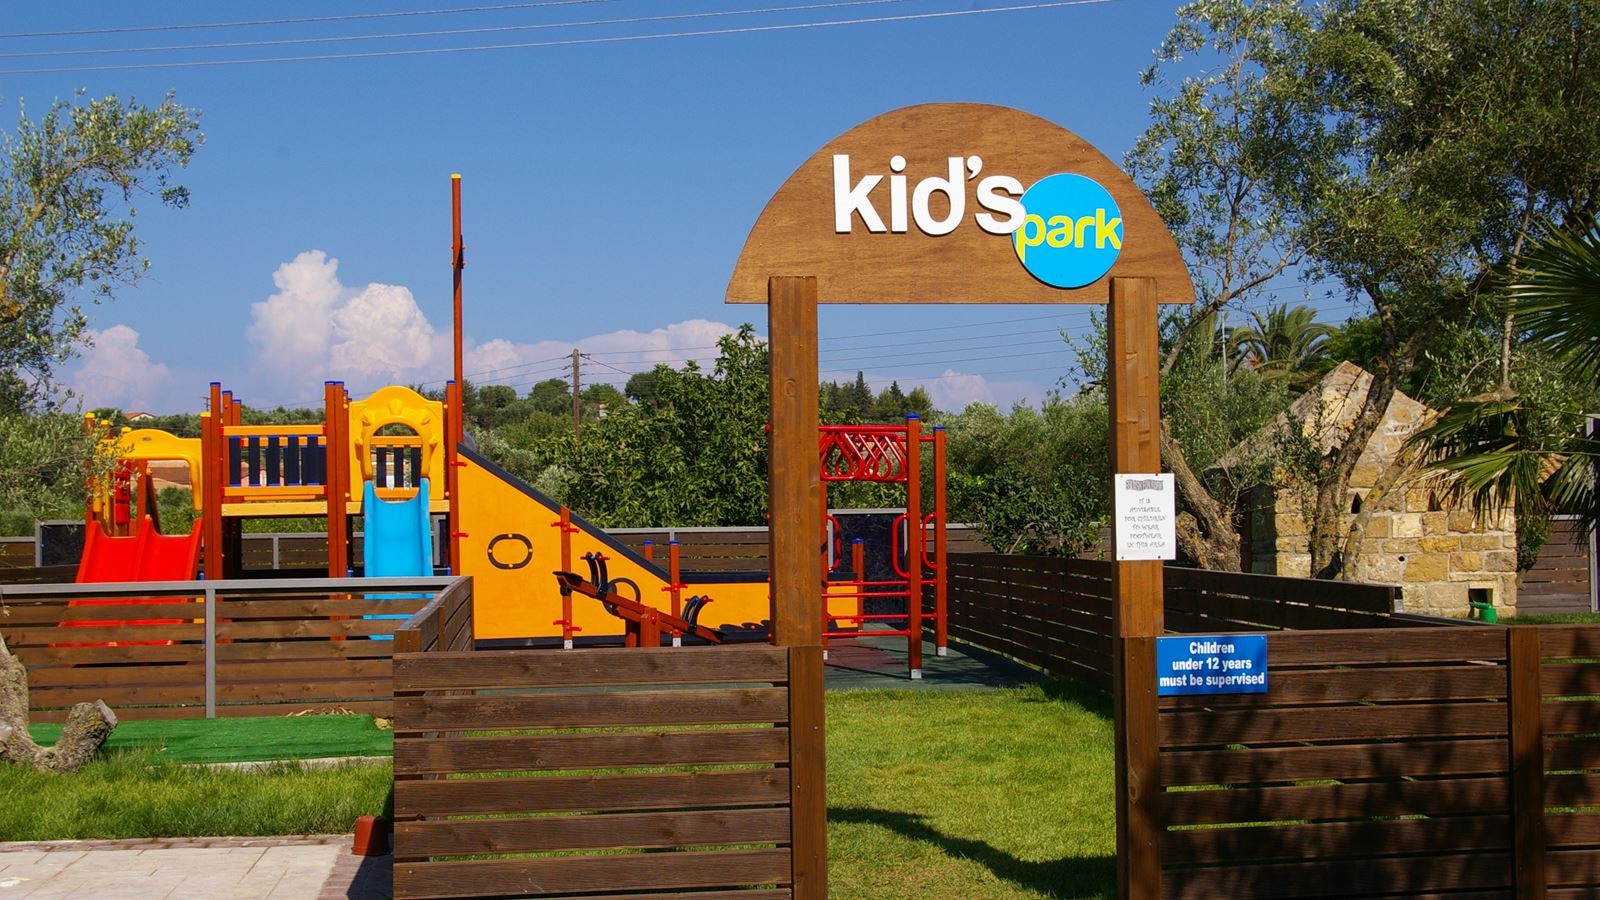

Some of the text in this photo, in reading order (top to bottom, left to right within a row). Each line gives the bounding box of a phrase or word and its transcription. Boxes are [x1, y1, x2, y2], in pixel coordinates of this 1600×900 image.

[833, 154, 1027, 236] kid's
[1015, 208, 1122, 263] park
[1189, 641, 1235, 655] Children
[1172, 657, 1252, 672] under 12 years
[1159, 672, 1265, 688] must be supervised
